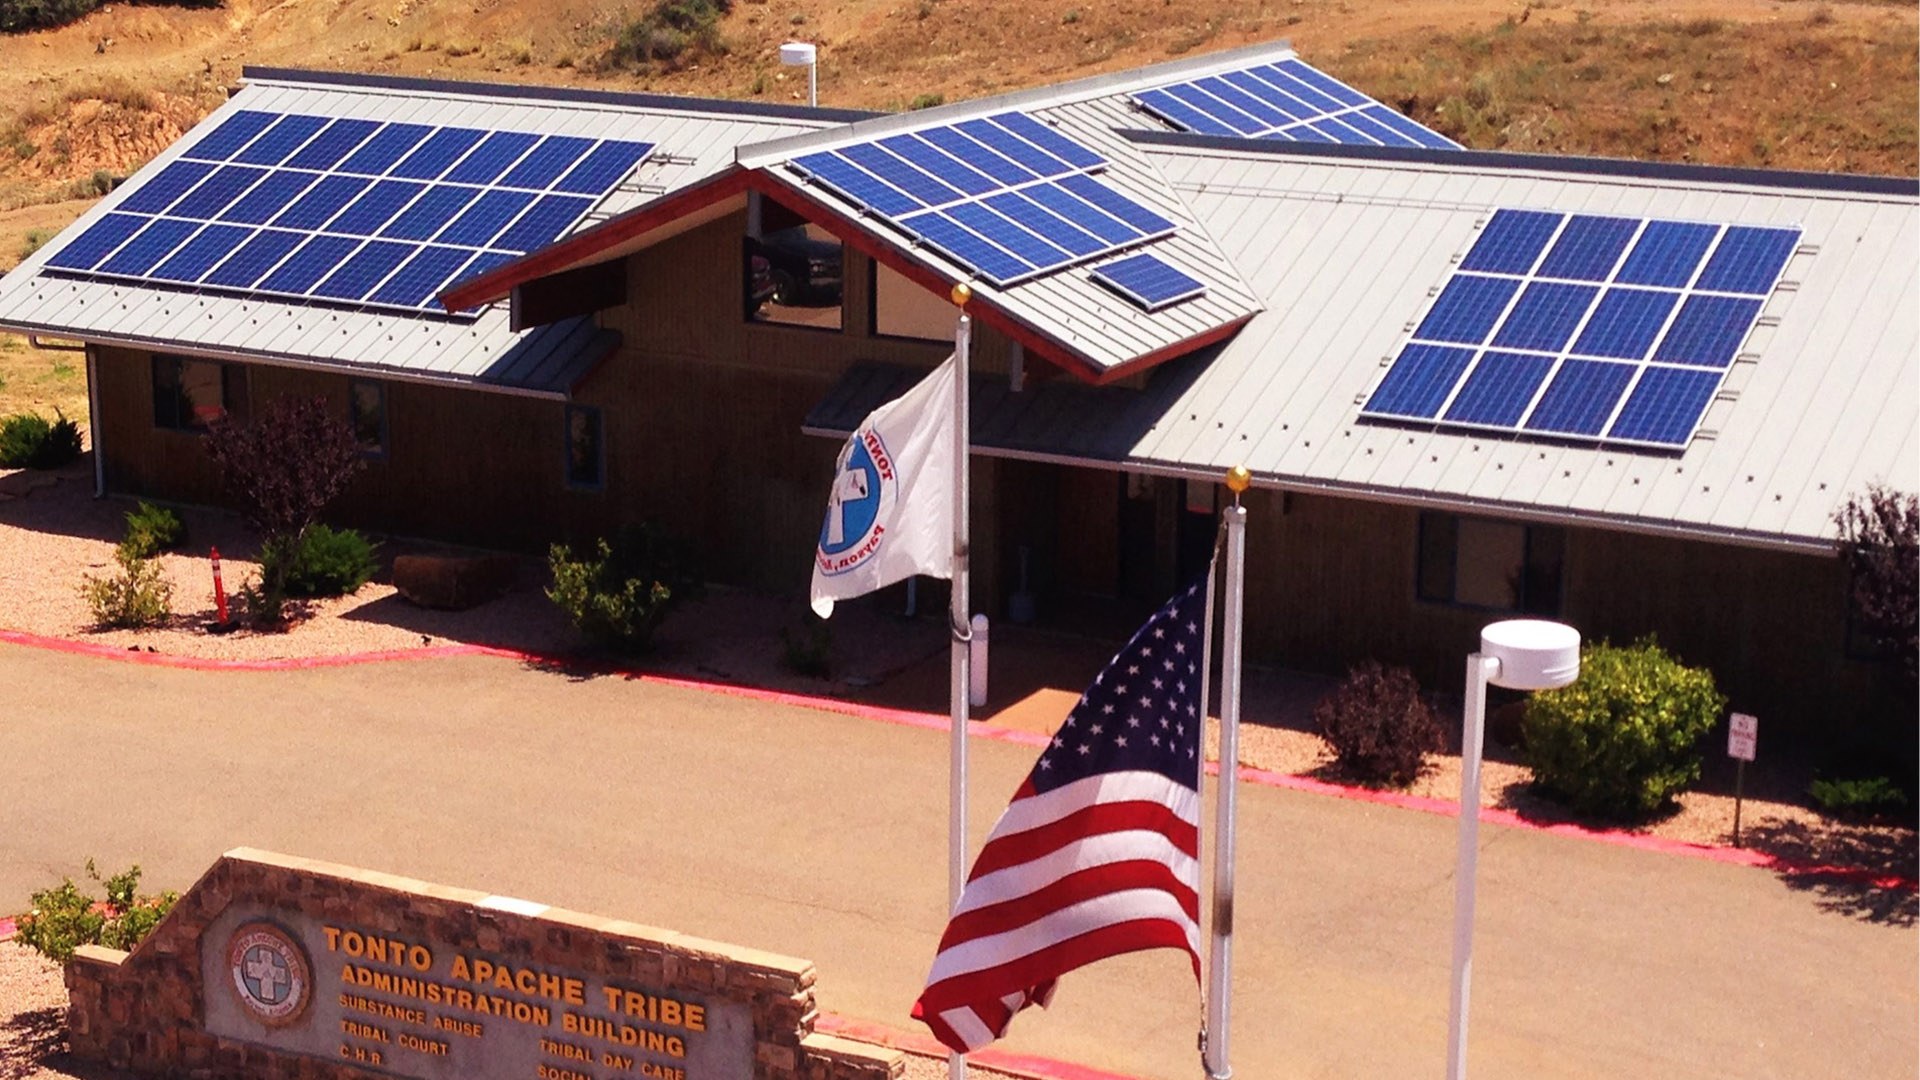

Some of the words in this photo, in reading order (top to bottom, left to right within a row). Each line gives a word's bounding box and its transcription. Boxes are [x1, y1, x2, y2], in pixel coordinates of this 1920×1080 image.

[323, 926, 432, 972] TONTO
[452, 954, 585, 1006] APACHE
[602, 986, 706, 1032] TRIBE
[339, 994, 425, 1025] SUBSTANCE
[434, 1016, 483, 1038] ABUSE
[341, 964, 549, 1026] ADMINISTRATION
[562, 1012, 684, 1057] BUILDING
[339, 1019, 389, 1043] TRIBAL
[398, 1034, 448, 1056] COURT
[539, 1038, 593, 1063] TRIBAL
[602, 1052, 633, 1070] DAY
[641, 1062, 685, 1080] CARE
